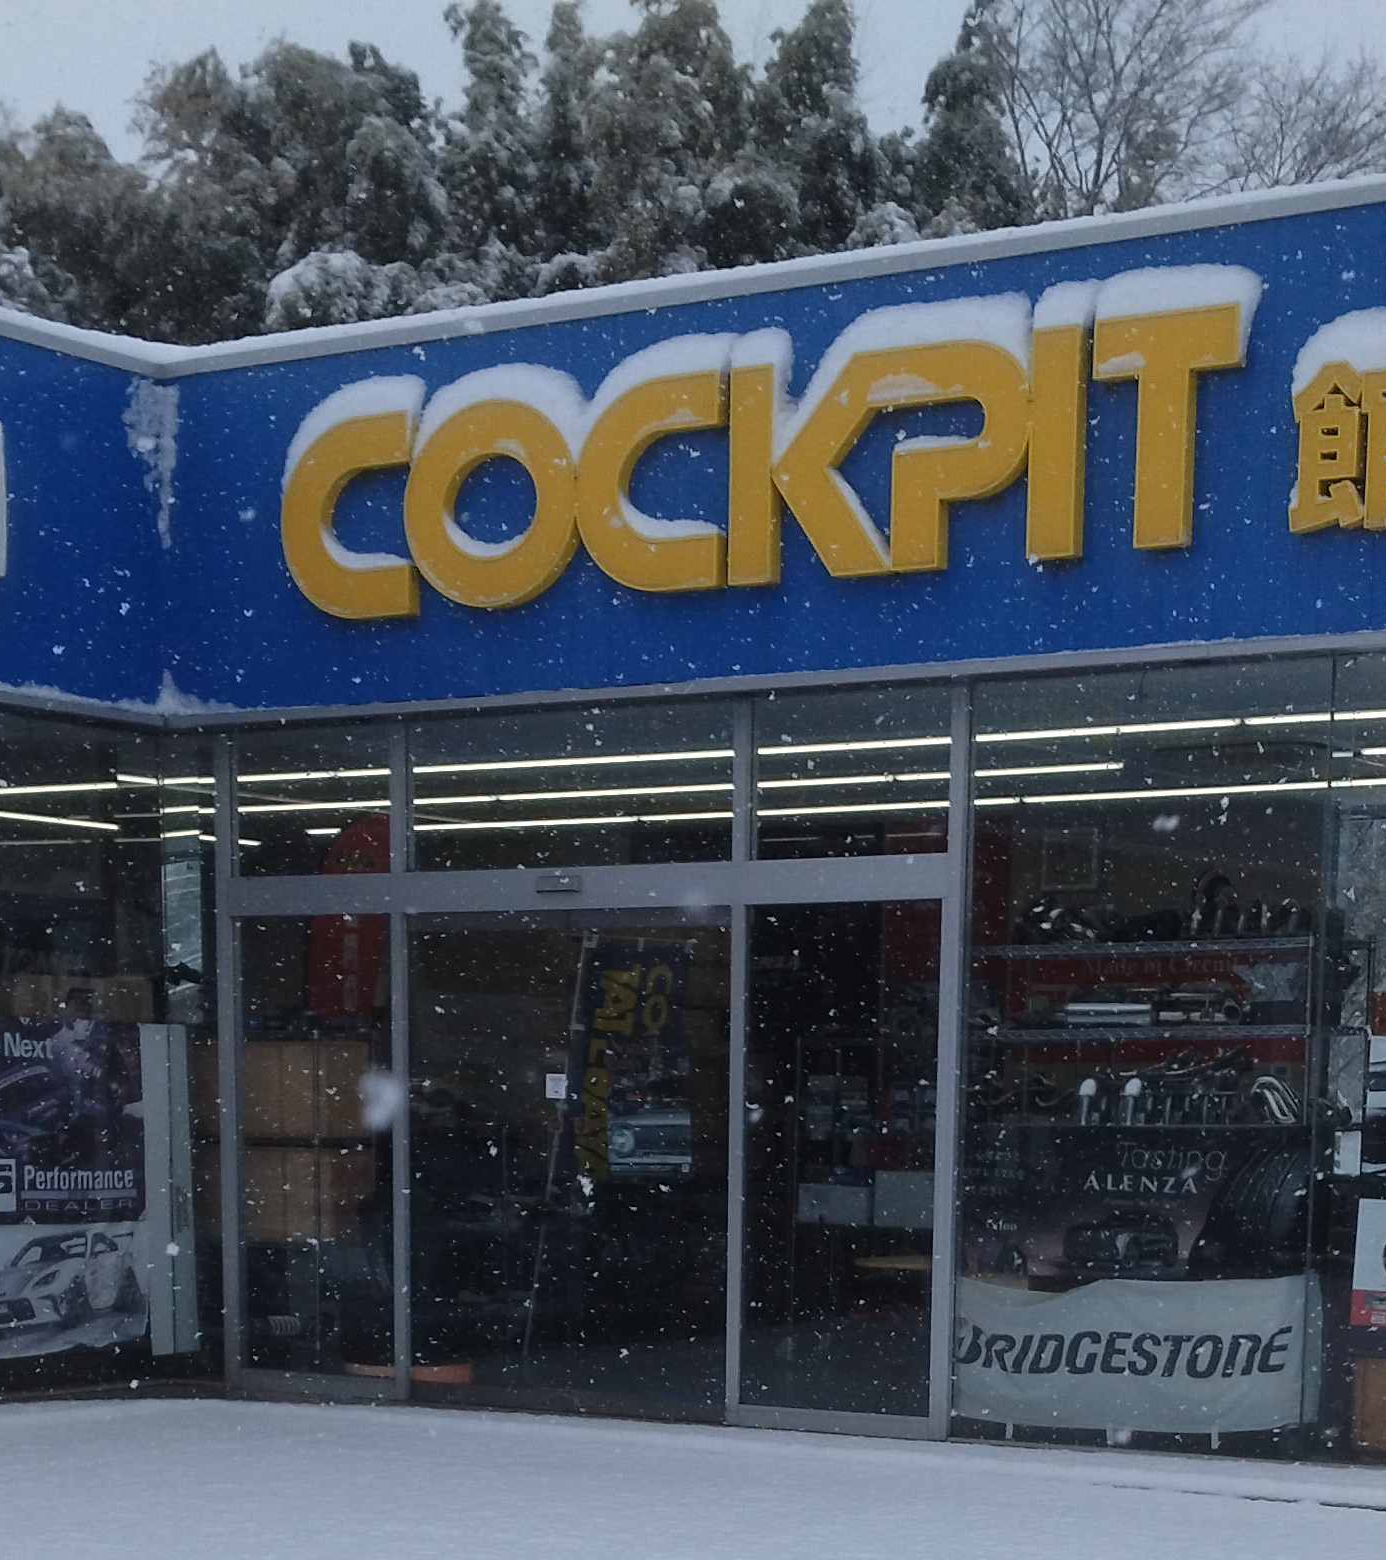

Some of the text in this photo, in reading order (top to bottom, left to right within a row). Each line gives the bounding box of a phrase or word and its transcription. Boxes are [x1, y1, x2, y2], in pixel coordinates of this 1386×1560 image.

[280, 301, 1246, 620] COCKPIT
[4, 1031, 54, 1060] Next
[1119, 1141, 1229, 1182] Tasting
[23, 1164, 134, 1191] Performance
[1083, 1170, 1199, 1196] ALENZA
[24, 1197, 133, 1212] DEALER
